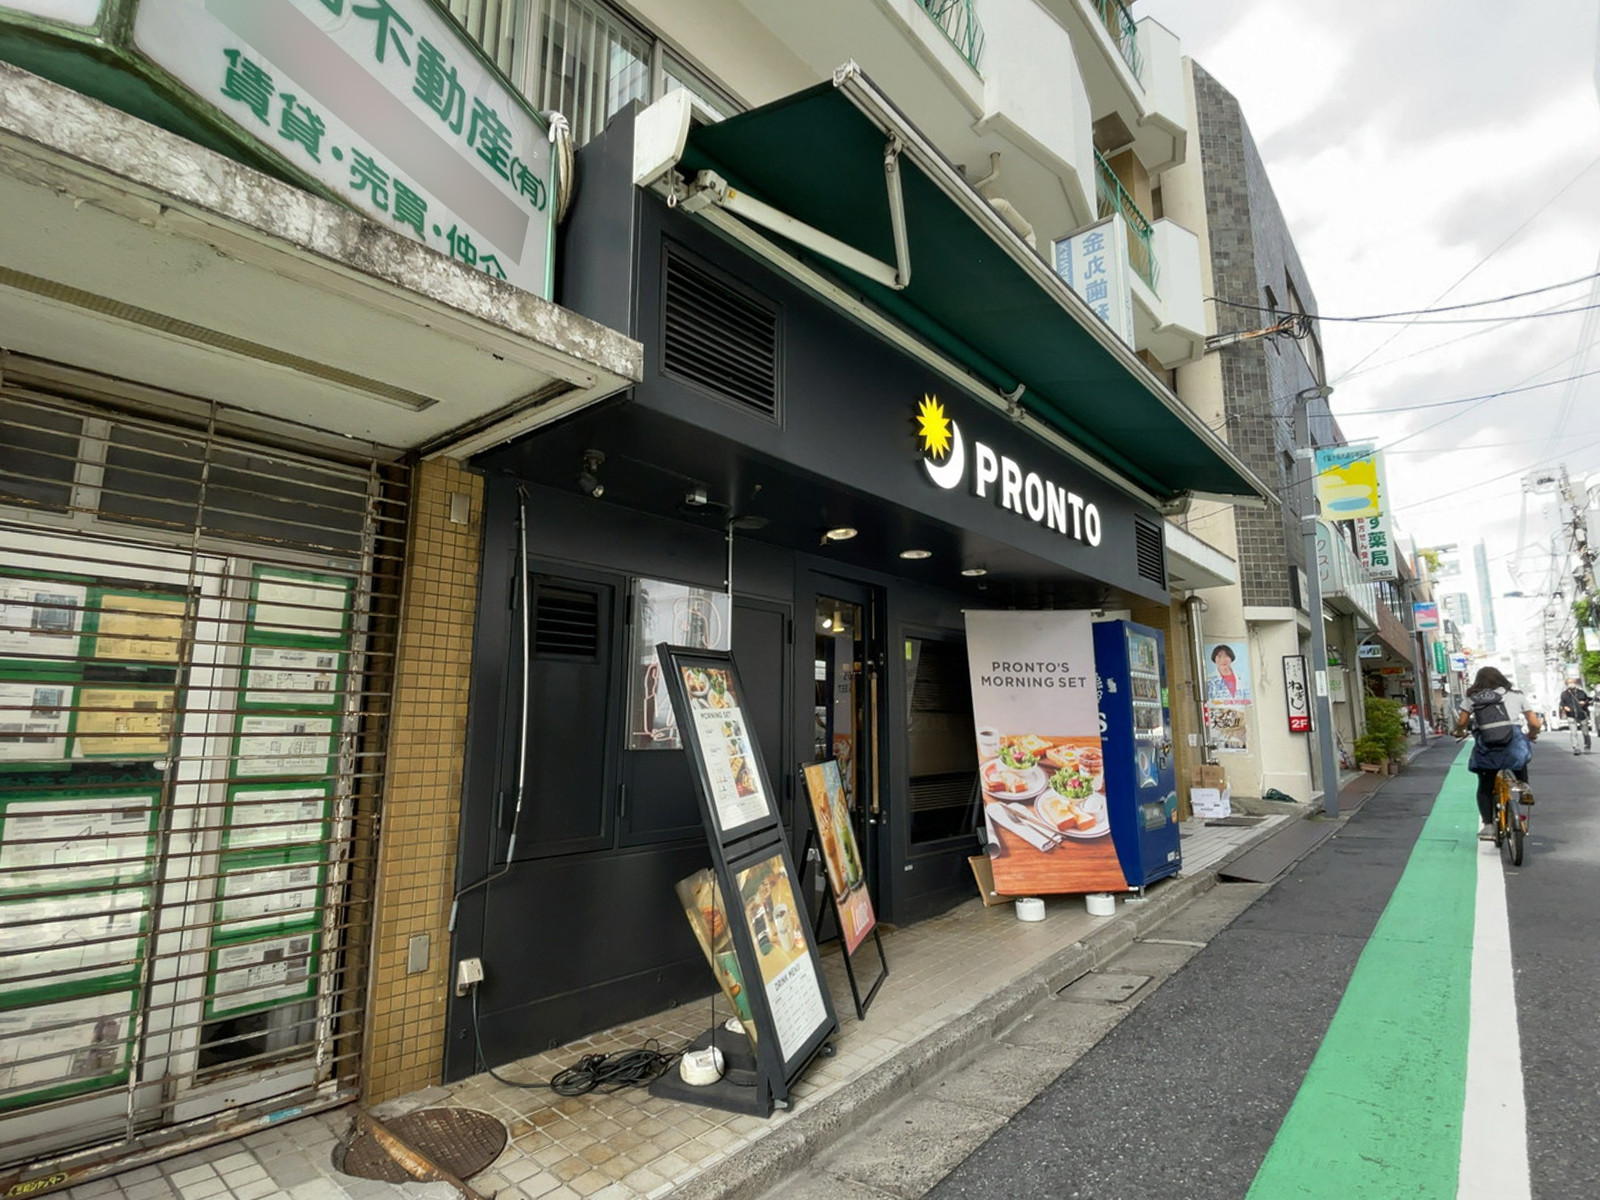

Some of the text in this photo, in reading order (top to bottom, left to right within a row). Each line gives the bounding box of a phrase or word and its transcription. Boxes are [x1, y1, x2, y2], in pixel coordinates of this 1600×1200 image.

[313, 0, 547, 212] 不動産(有)
[975, 441, 1101, 547] PRONTO
[992, 661, 1070, 673] PRONTO'S
[981, 676, 1086, 688] MORNING SET
[1287, 680, 1305, 710] ねぎし
[1291, 719, 1308, 729] 2F
